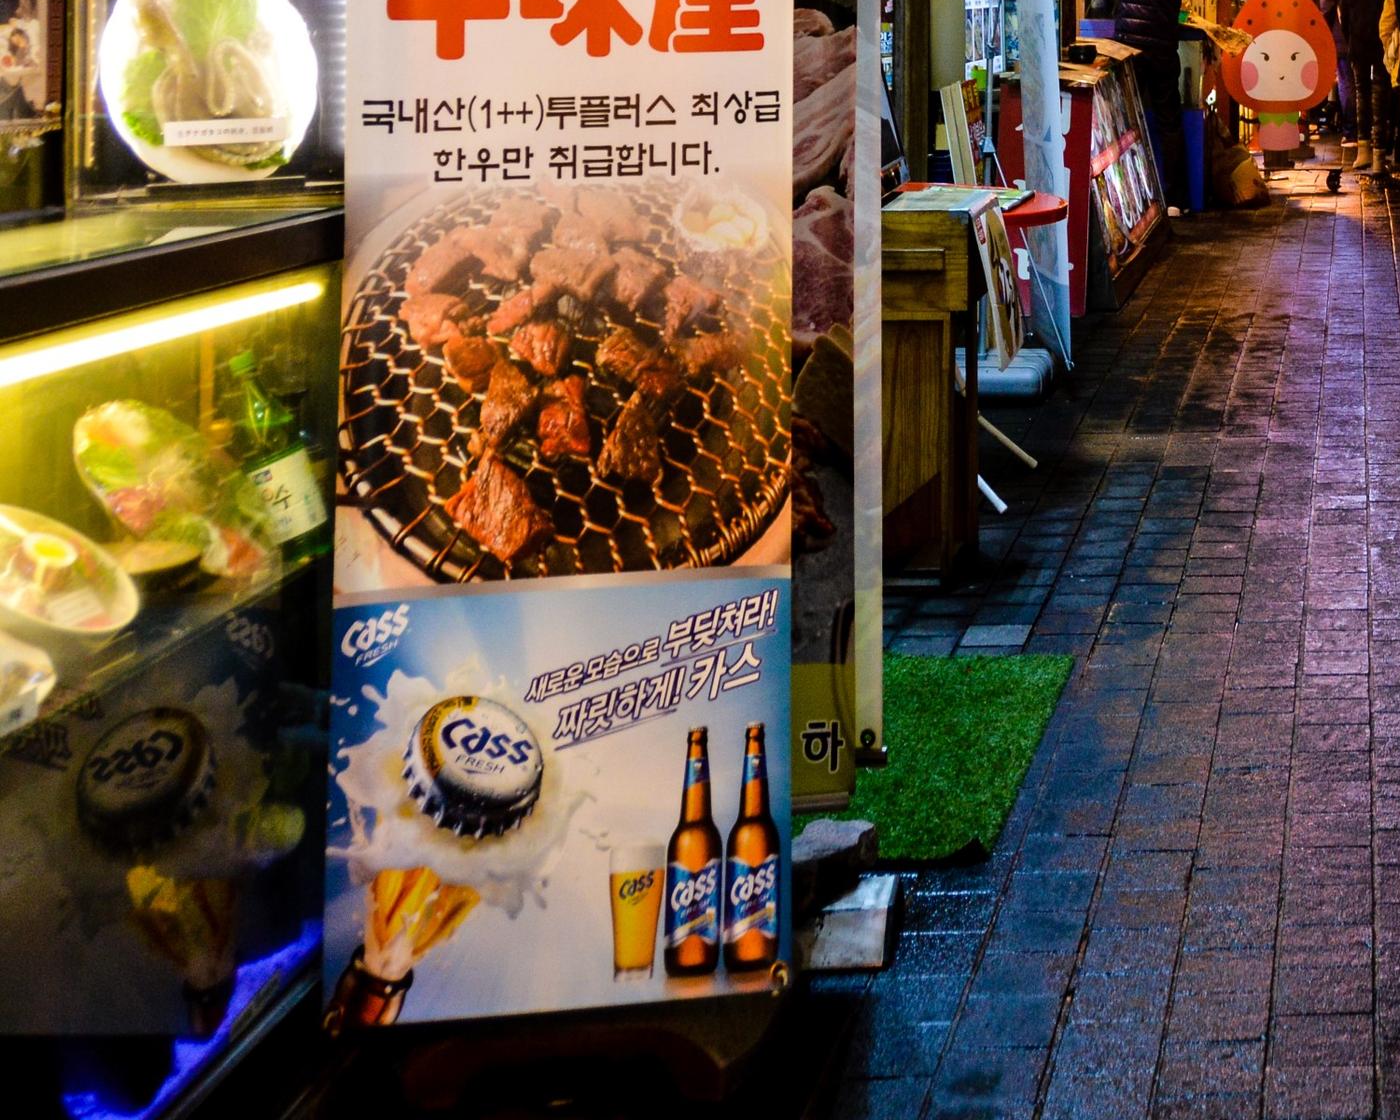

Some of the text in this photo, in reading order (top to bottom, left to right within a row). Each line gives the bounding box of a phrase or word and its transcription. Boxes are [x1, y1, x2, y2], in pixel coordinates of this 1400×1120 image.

[361, 89, 782, 134] 국내산(1++)투플러스 최상급
[432, 140, 721, 183] 한우만 취급합니다.
[340, 602, 412, 656] Cass
[583, 636, 661, 678] 모습으로
[685, 640, 763, 702] 카스
[439, 715, 534, 768] Cass
[454, 753, 507, 778] FRESH
[800, 720, 846, 773] 하
[617, 868, 656, 901] Cass
[669, 861, 719, 910] Cass
[730, 856, 777, 906] Cass
